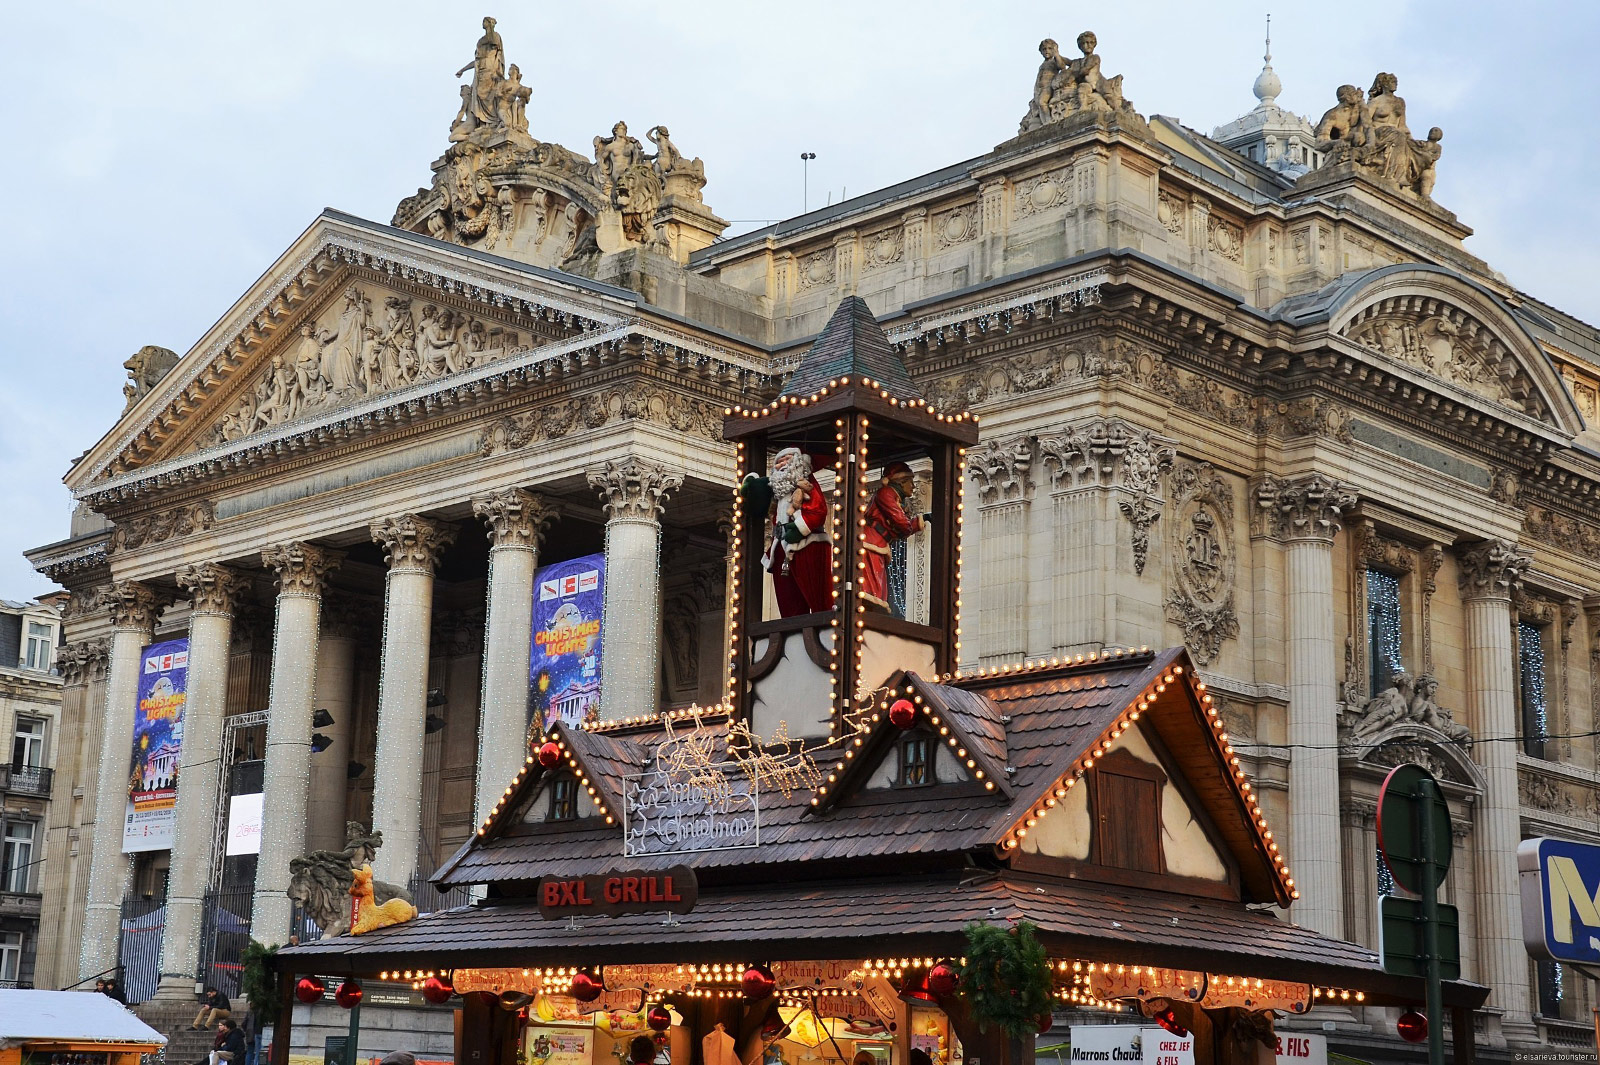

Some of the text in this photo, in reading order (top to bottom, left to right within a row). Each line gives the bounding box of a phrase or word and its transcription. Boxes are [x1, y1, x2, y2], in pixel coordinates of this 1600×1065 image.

[535, 620, 600, 645] CHRISTMAS
[545, 637, 588, 656] LIGHTS
[146, 705, 176, 720] LIGHTS
[544, 876, 681, 906] BXL GRILL
[780, 961, 823, 977] Pikante
[819, 996, 854, 1014] Boudin
[1072, 1047, 1109, 1061] Marrons
[1159, 1041, 1190, 1051] CHEZ JEF
[1287, 1037, 1310, 1057] FILS
[1156, 1056, 1178, 1065] & FILS
